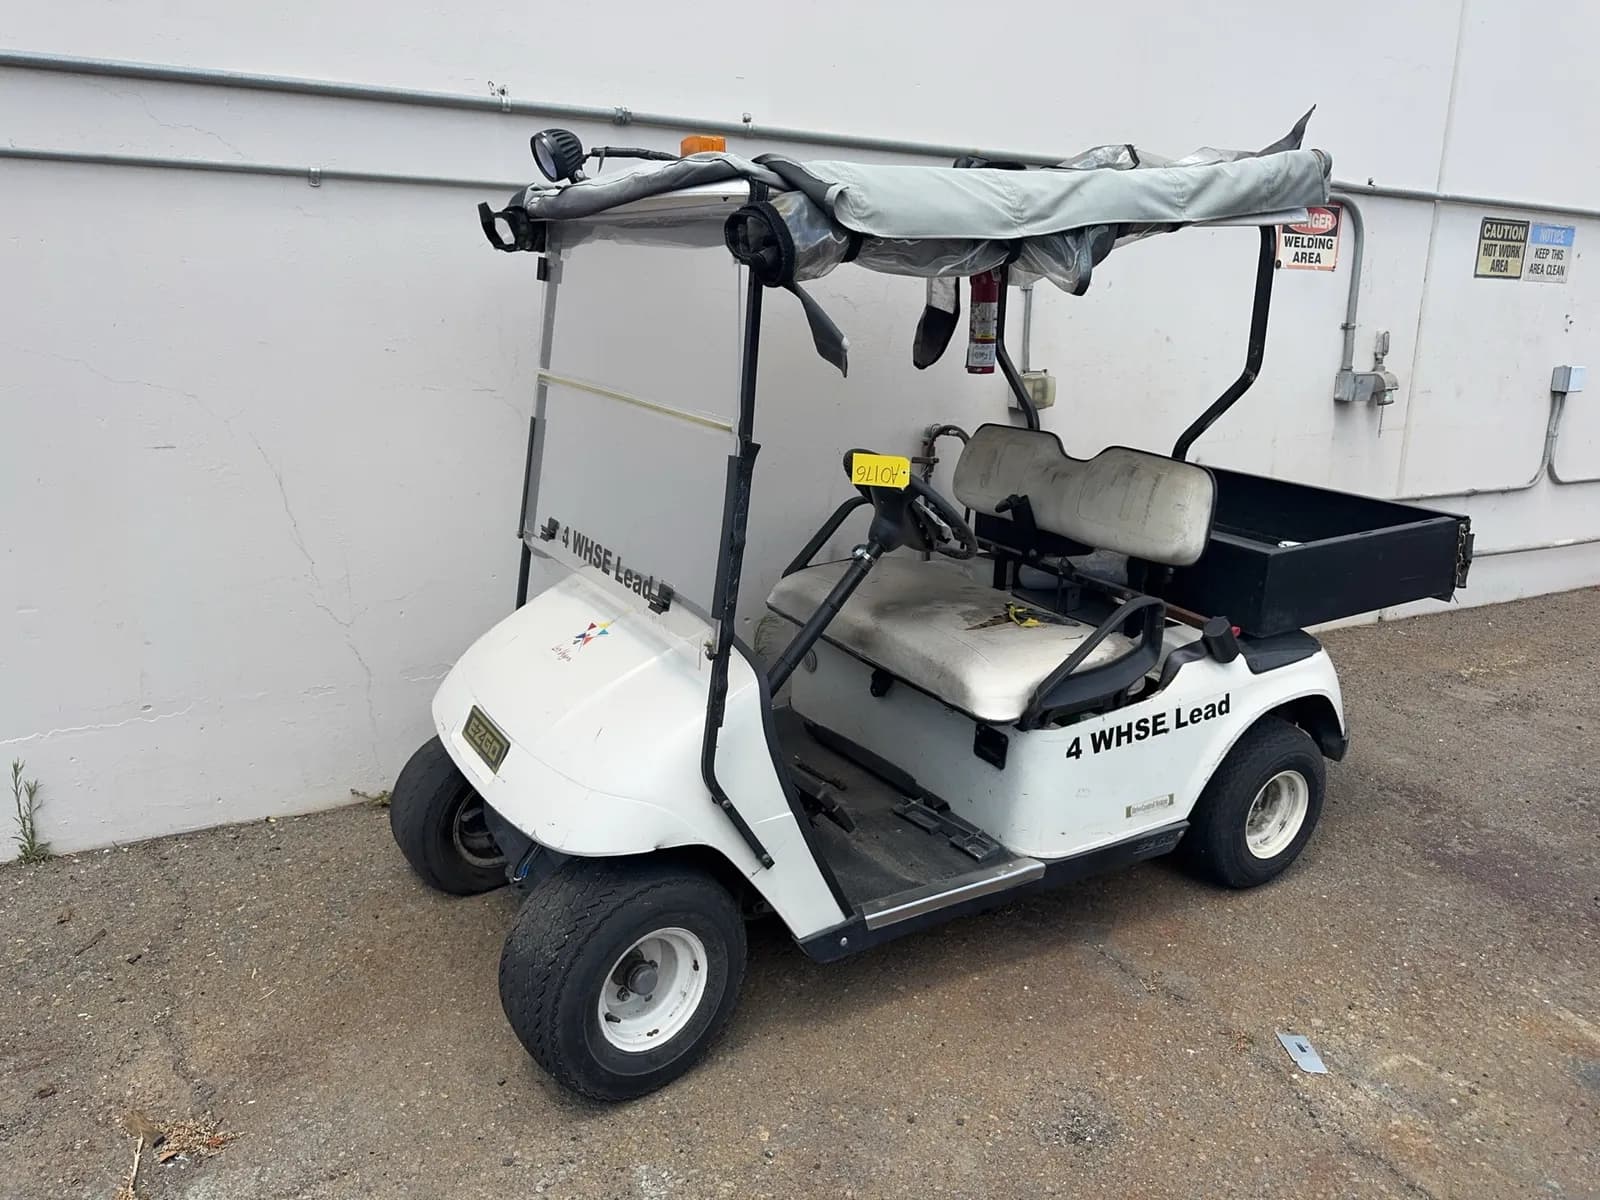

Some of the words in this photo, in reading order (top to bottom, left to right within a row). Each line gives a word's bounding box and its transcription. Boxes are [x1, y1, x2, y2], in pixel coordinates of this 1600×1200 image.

[1483, 223, 1526, 241] CAUTION
[1284, 235, 1334, 250] WELDING
[1292, 251, 1322, 265] AREA
[1482, 243, 1498, 257] HOT
[1498, 244, 1522, 259] WORK
[1534, 248, 1550, 259] KEEP
[1551, 249, 1565, 260] THIS
[1489, 259, 1509, 273] AREA
[1528, 263, 1545, 275] AREA
[1545, 264, 1566, 276] CLEAN
[562, 526, 570, 549] 4
[572, 530, 613, 576] WHSE
[614, 556, 654, 601] Lead
[1065, 737, 1083, 760] 4
[1090, 712, 1169, 754] WHSE
[1175, 692, 1231, 730] Lead
